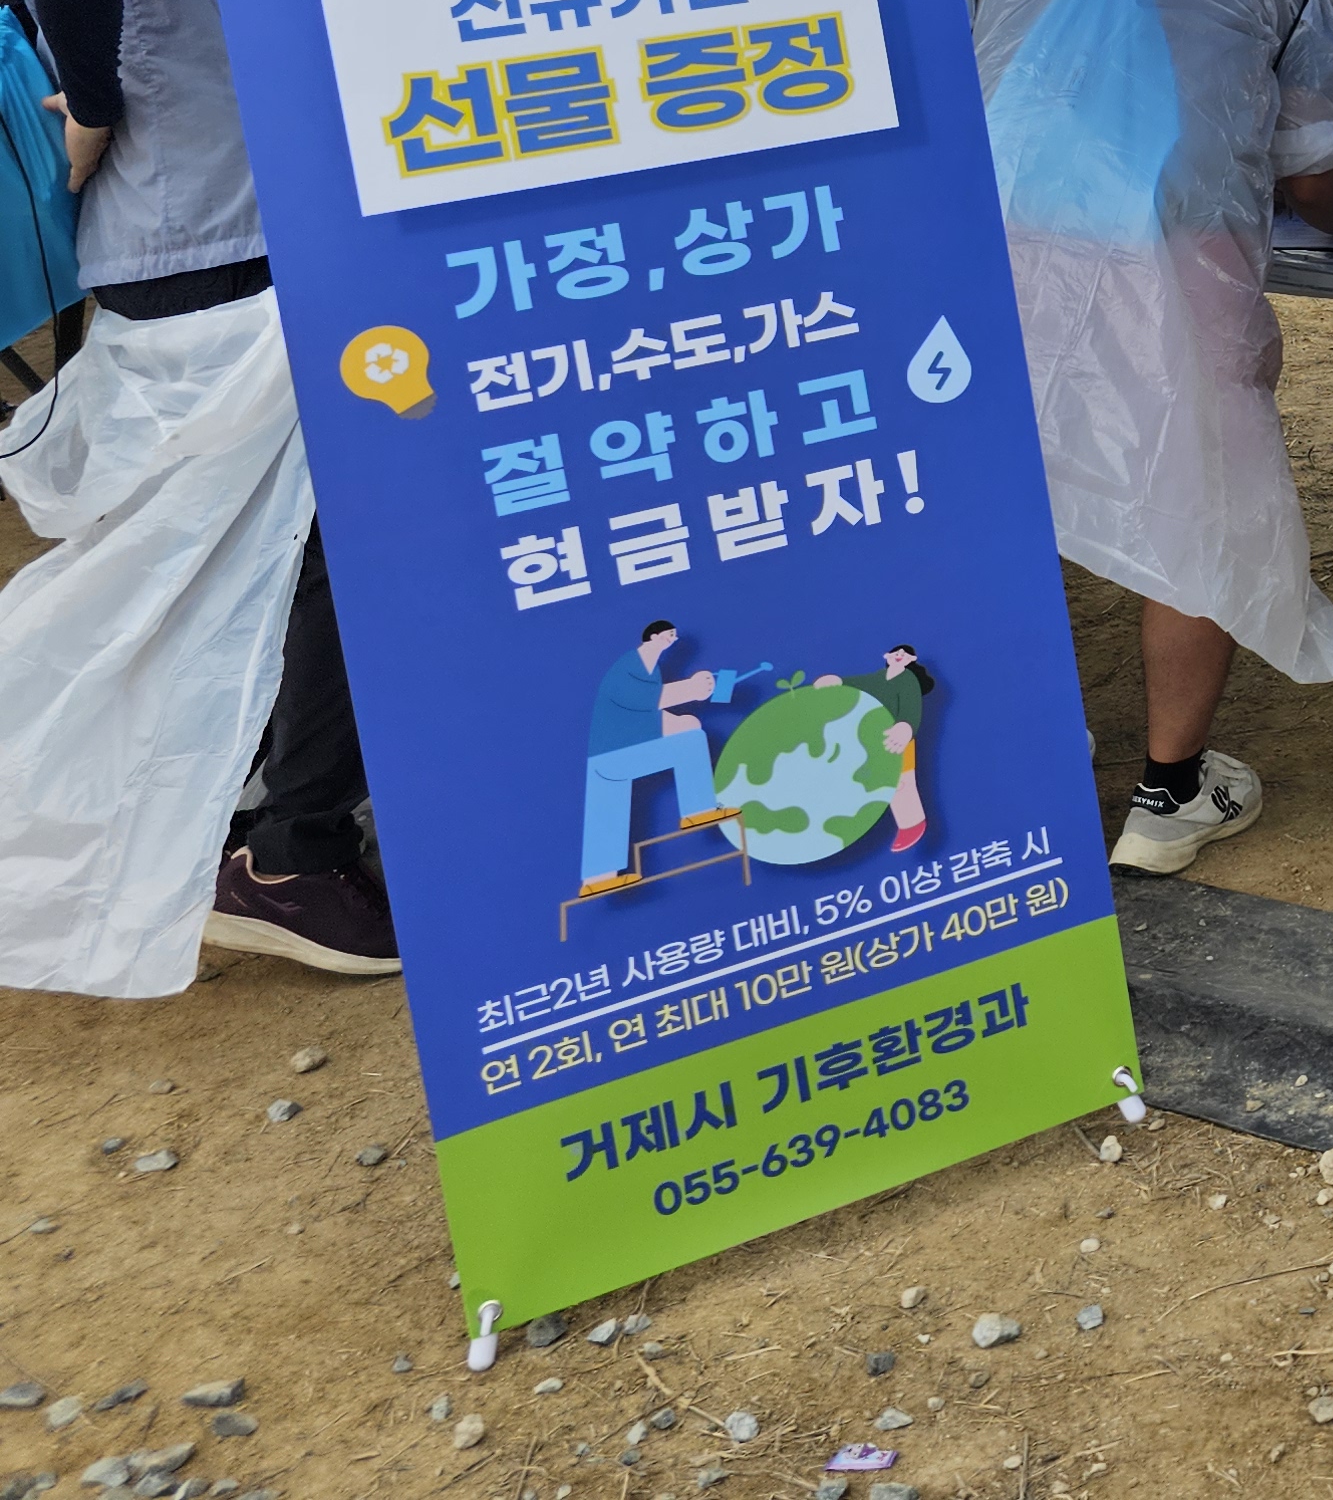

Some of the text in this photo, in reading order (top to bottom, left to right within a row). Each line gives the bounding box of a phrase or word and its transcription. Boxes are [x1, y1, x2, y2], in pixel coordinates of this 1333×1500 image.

[382, 12, 854, 177] 선물 증정
[477, 826, 1051, 1035] 최근2년 사용량 대비, 5% 이상 감축 시
[480, 875, 1070, 1096] 연 2회, 연 최대 10만 원(상가 40만 원)
[559, 982, 1031, 1183] 거제시 기후환경과
[653, 1079, 971, 1217] 055-639-4083
